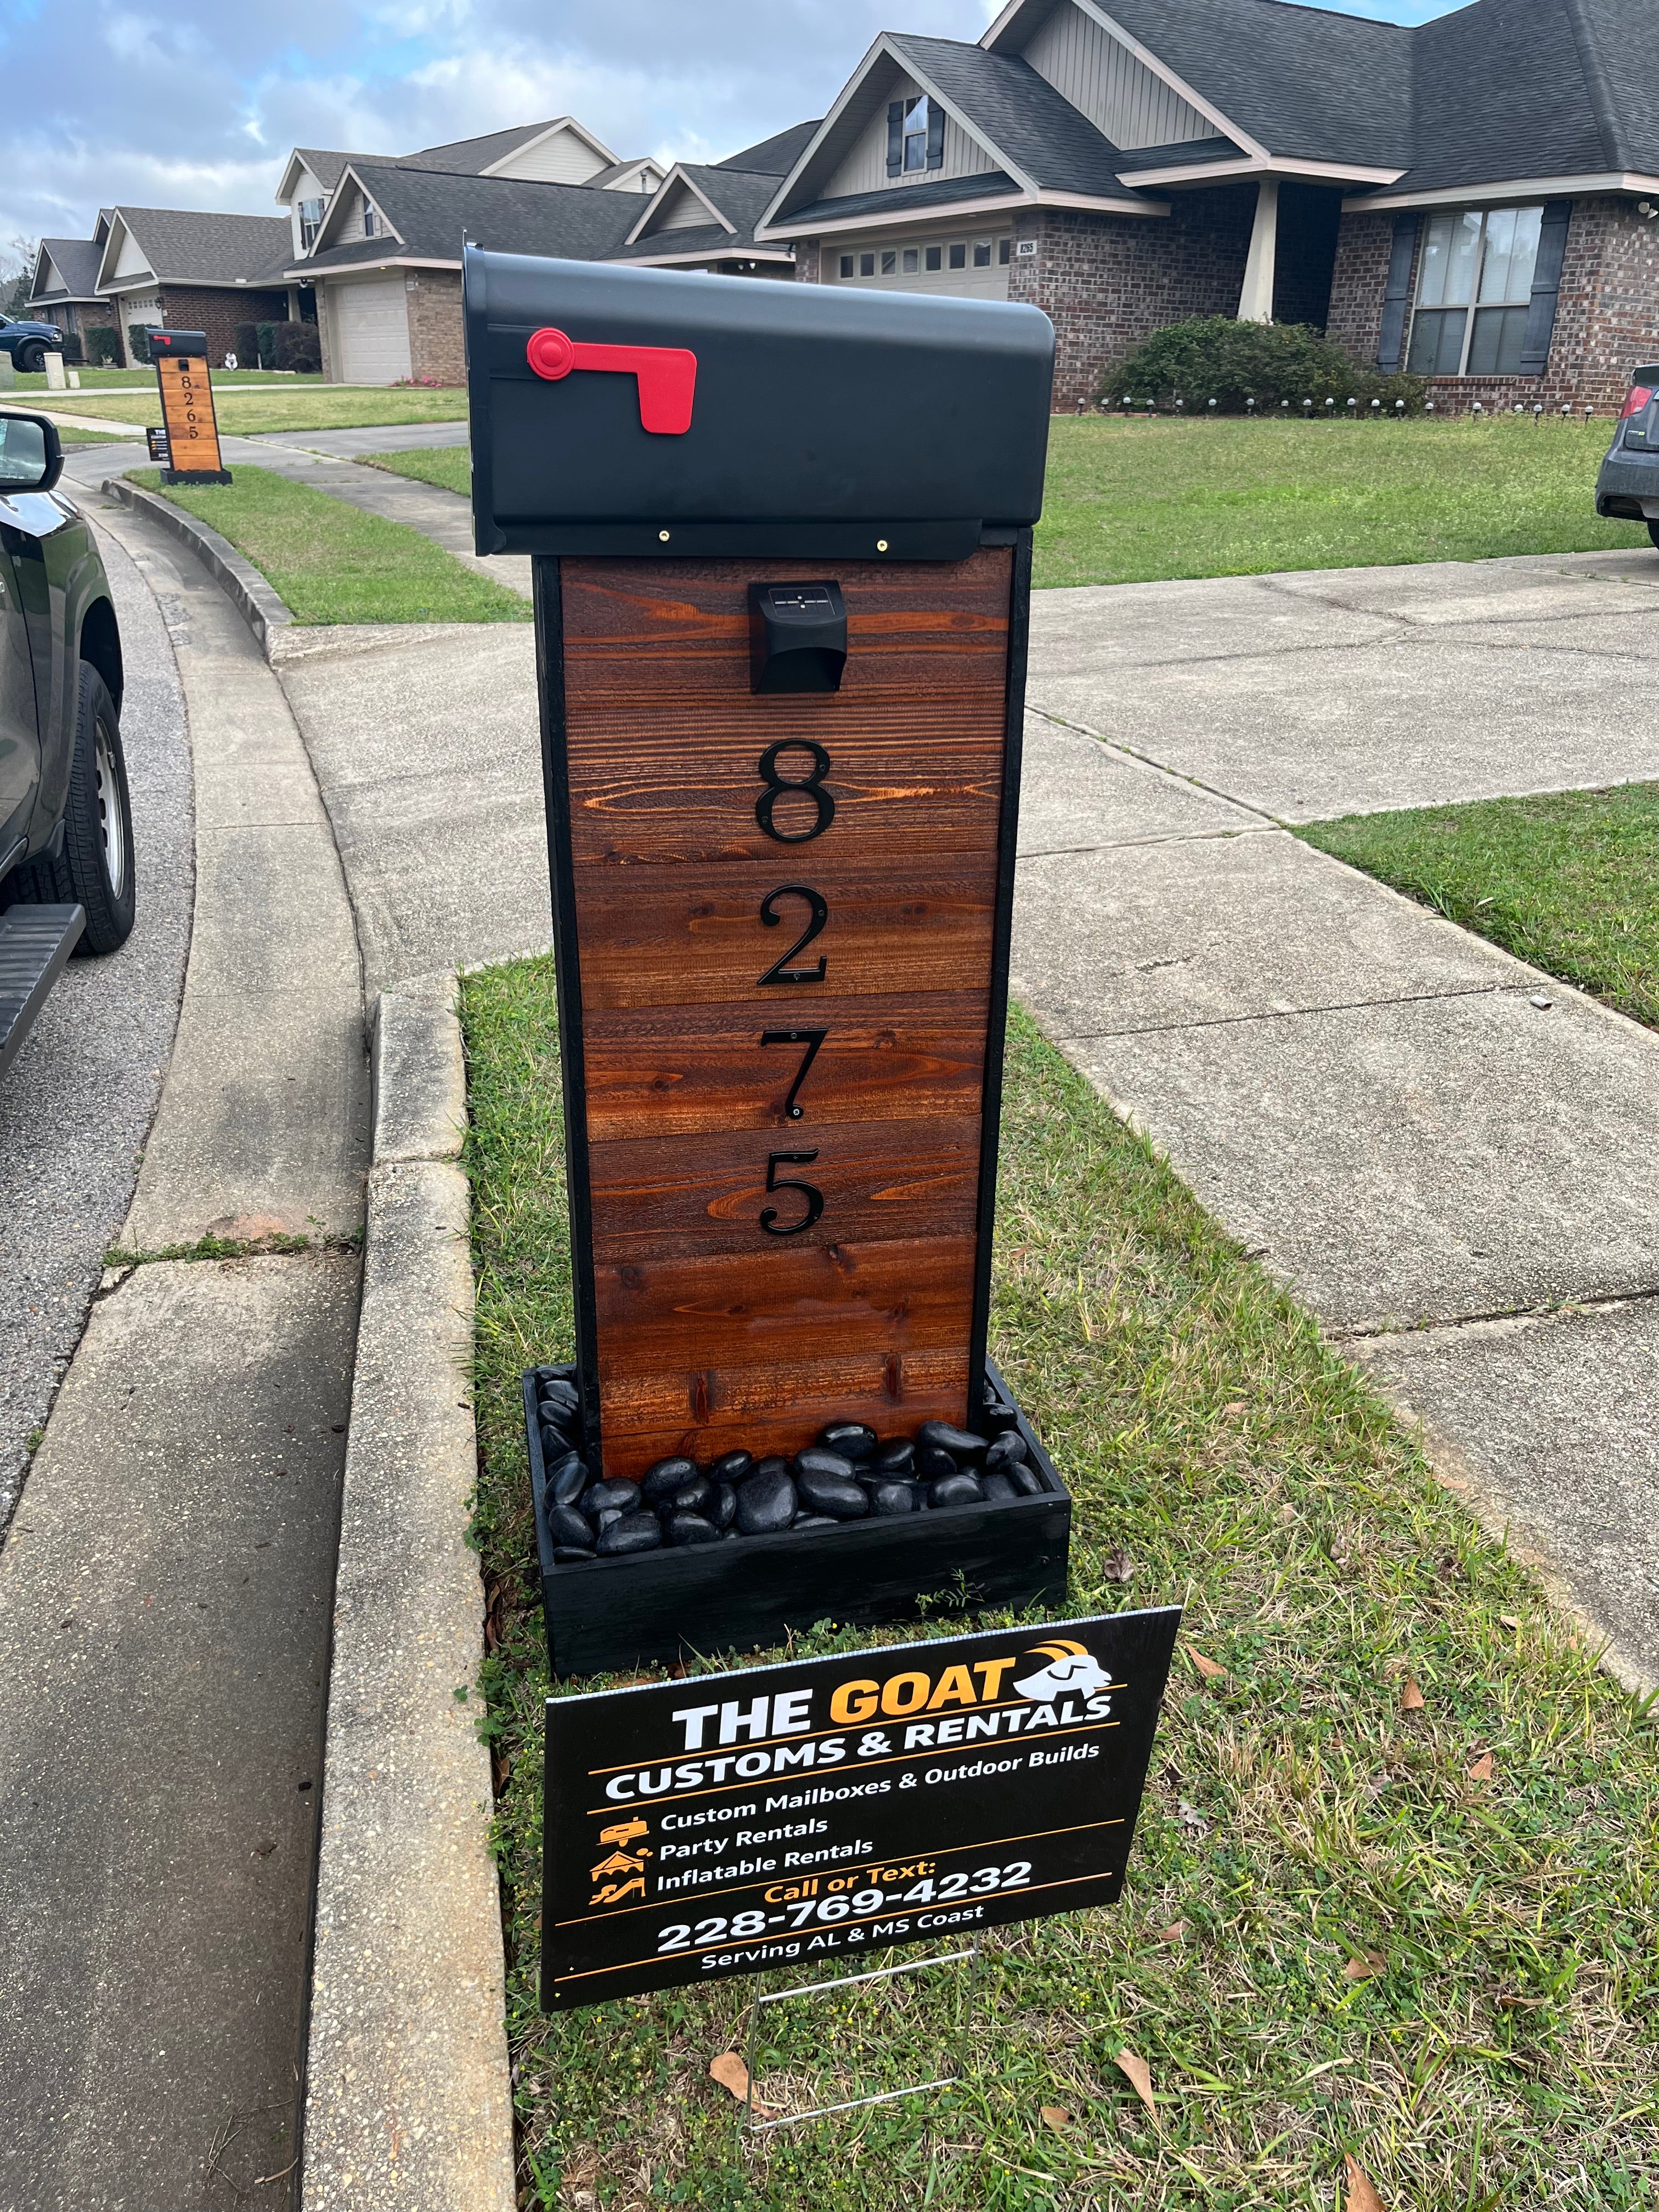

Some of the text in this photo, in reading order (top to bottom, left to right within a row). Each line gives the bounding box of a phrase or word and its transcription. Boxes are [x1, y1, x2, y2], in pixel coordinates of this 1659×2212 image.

[673, 1657, 1015, 1750] THE GOAT
[606, 1696, 1111, 1799] CUSTOMS & RENTALS
[662, 1743, 1099, 1830] Custom Mailboxes & Outdoor Builds
[658, 1839, 872, 1891] Inflatable Rentals
[661, 1819, 827, 1860] Party Rentals
[658, 1862, 1031, 1951] 228-769-4232
[765, 1861, 935, 1902] Call or Text:
[702, 1906, 984, 1968] Serving AL & MS Coast
